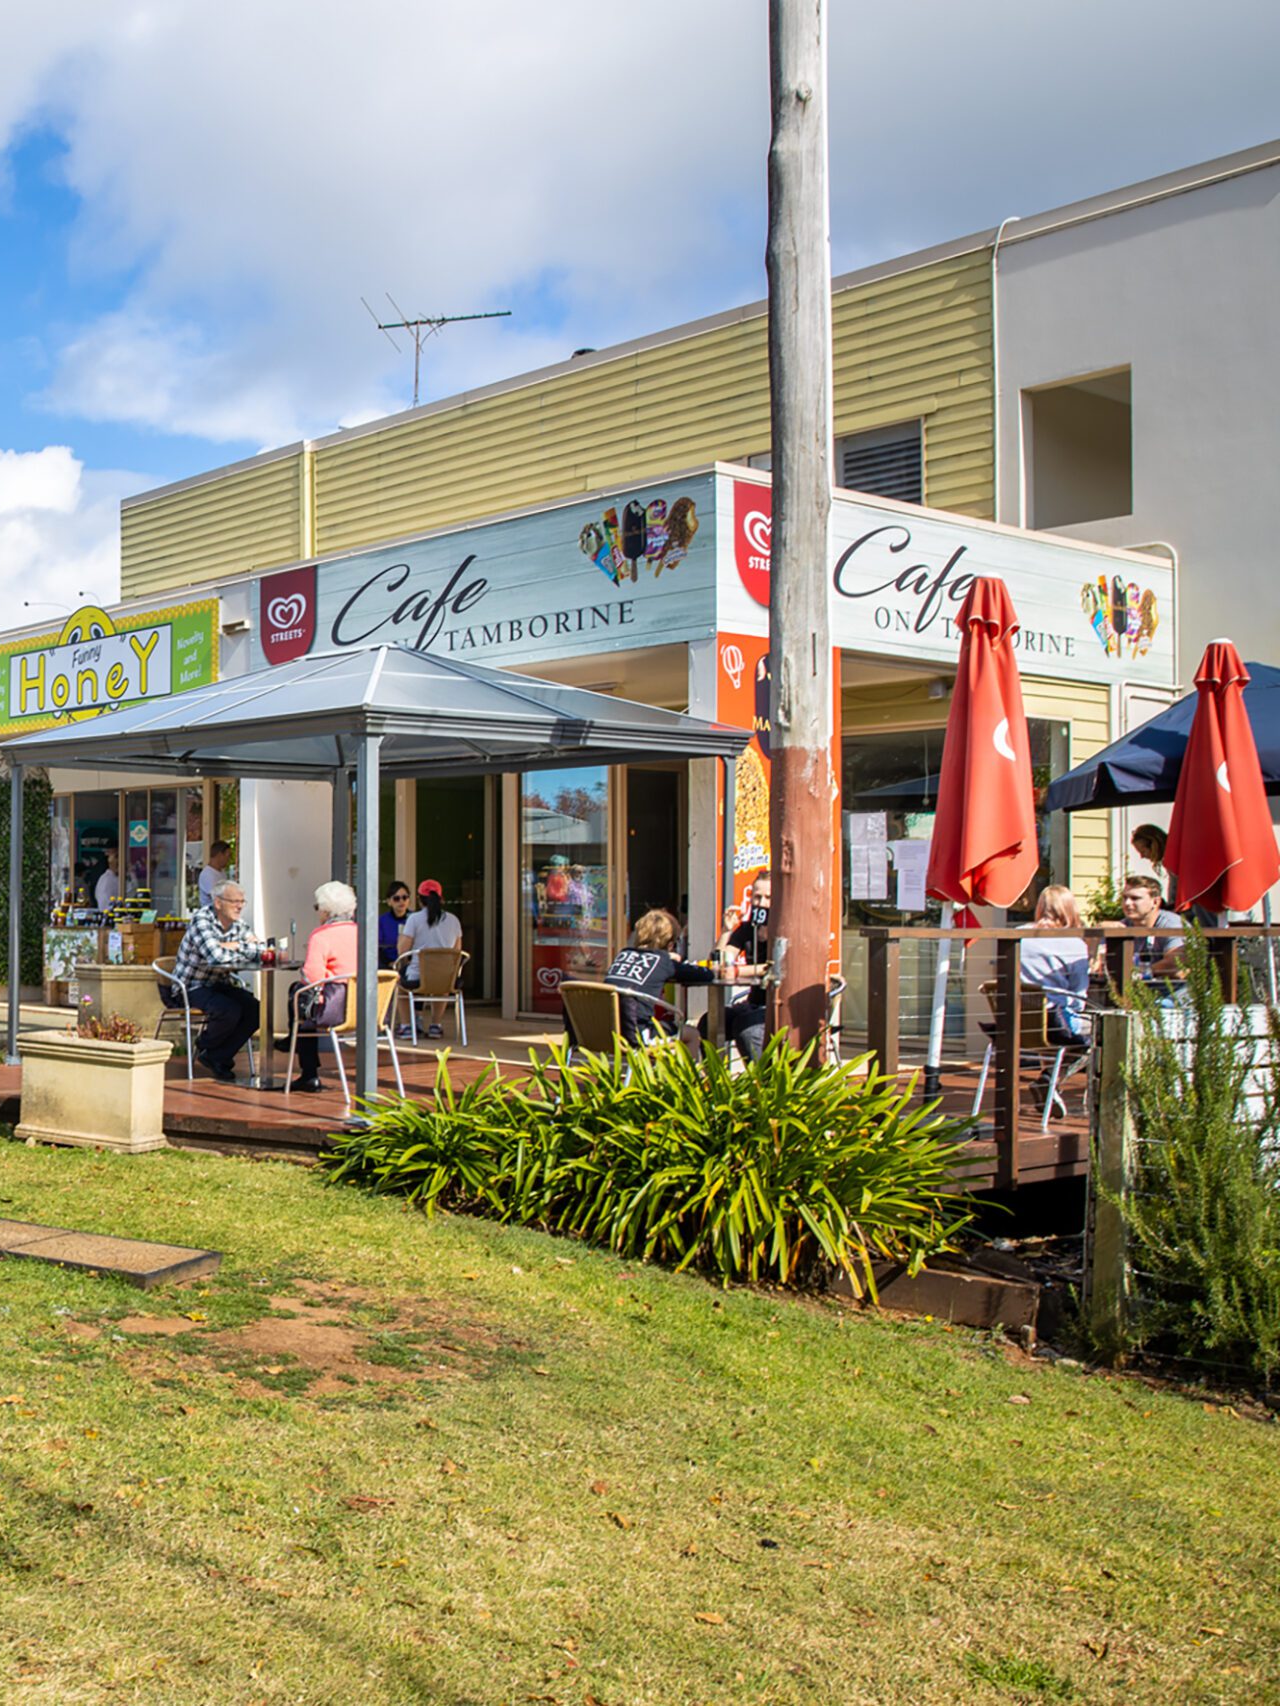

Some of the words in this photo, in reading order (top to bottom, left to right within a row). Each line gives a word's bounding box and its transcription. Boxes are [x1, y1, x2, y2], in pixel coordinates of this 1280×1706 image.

[748, 555, 771, 571] STRE
[833, 525, 977, 633] Cafe
[331, 554, 491, 651] Cafe
[444, 599, 635, 652] TAMBORINE
[874, 606, 910, 632] ON
[270, 628, 303, 644] STREETS
[72, 643, 103, 668] Funny
[752, 908, 767, 924] 19
